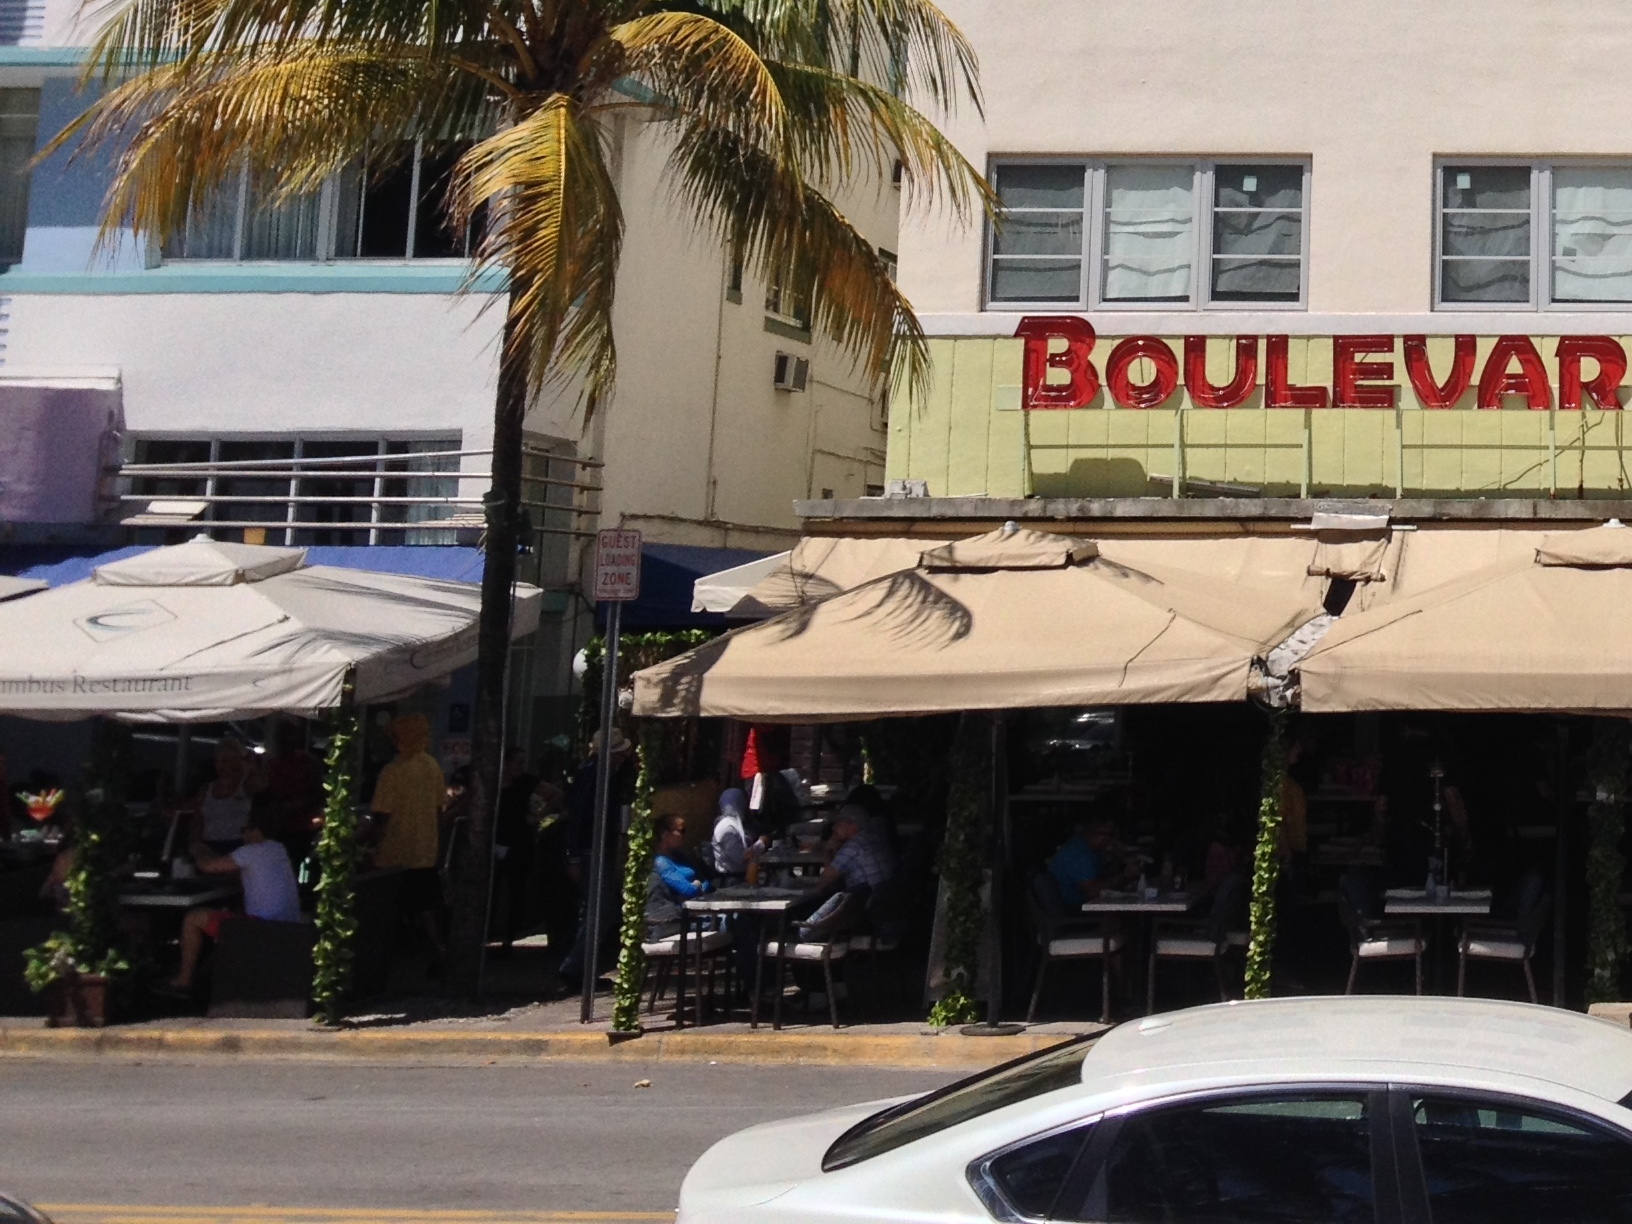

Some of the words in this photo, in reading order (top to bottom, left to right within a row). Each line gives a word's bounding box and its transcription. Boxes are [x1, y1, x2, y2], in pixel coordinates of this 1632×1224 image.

[601, 534, 637, 549] GUEST
[599, 553, 637, 567] LOADING
[601, 571, 632, 586] ZONE
[72, 674, 194, 694] Restaurant
